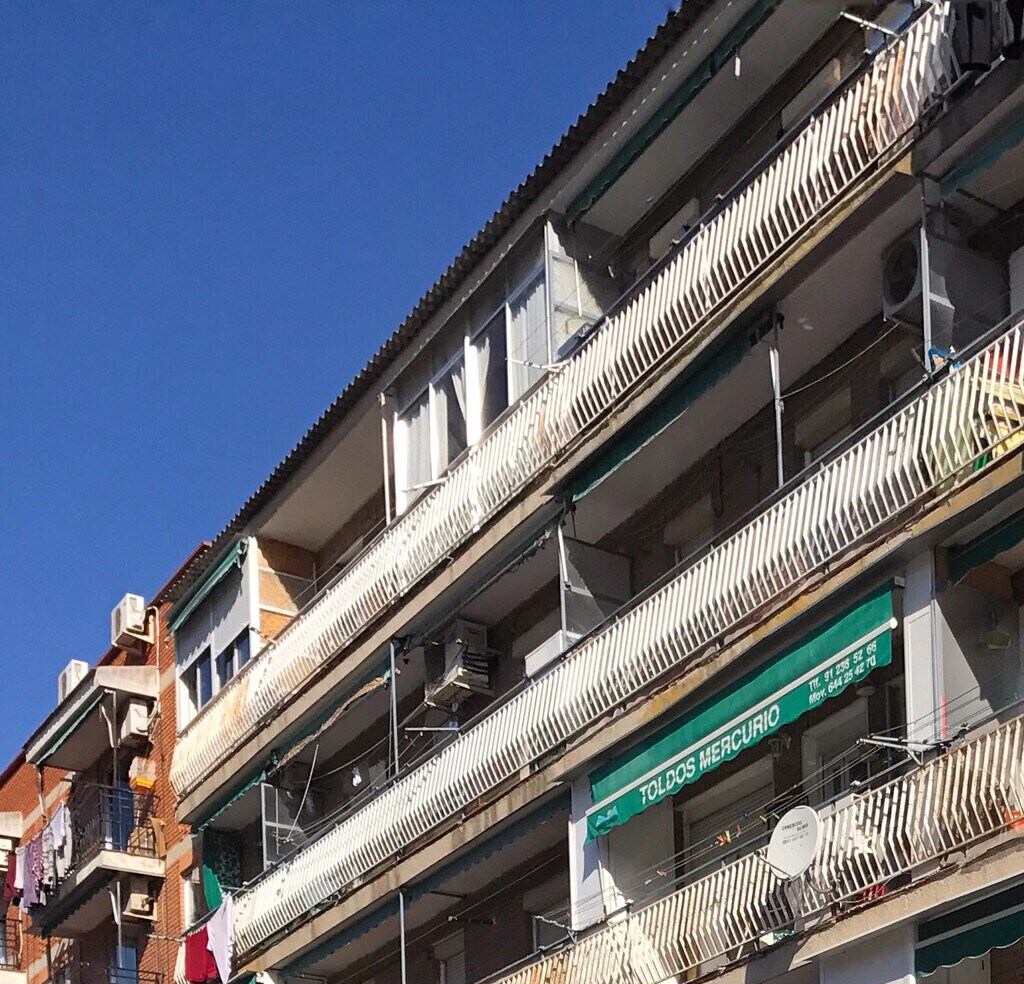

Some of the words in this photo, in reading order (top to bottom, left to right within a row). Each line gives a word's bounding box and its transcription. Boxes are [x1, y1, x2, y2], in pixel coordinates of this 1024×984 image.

[808, 689, 827, 705] Mov.
[828, 676, 842, 693] 644
[843, 669, 853, 684] 25
[854, 662, 864, 675] 42
[866, 654, 876, 668] 70
[824, 668, 833, 682] 91
[835, 658, 850, 675] 238
[853, 650, 863, 663] 52
[639, 757, 696, 805] TOLDOS
[699, 704, 780, 770] MERCURIO
